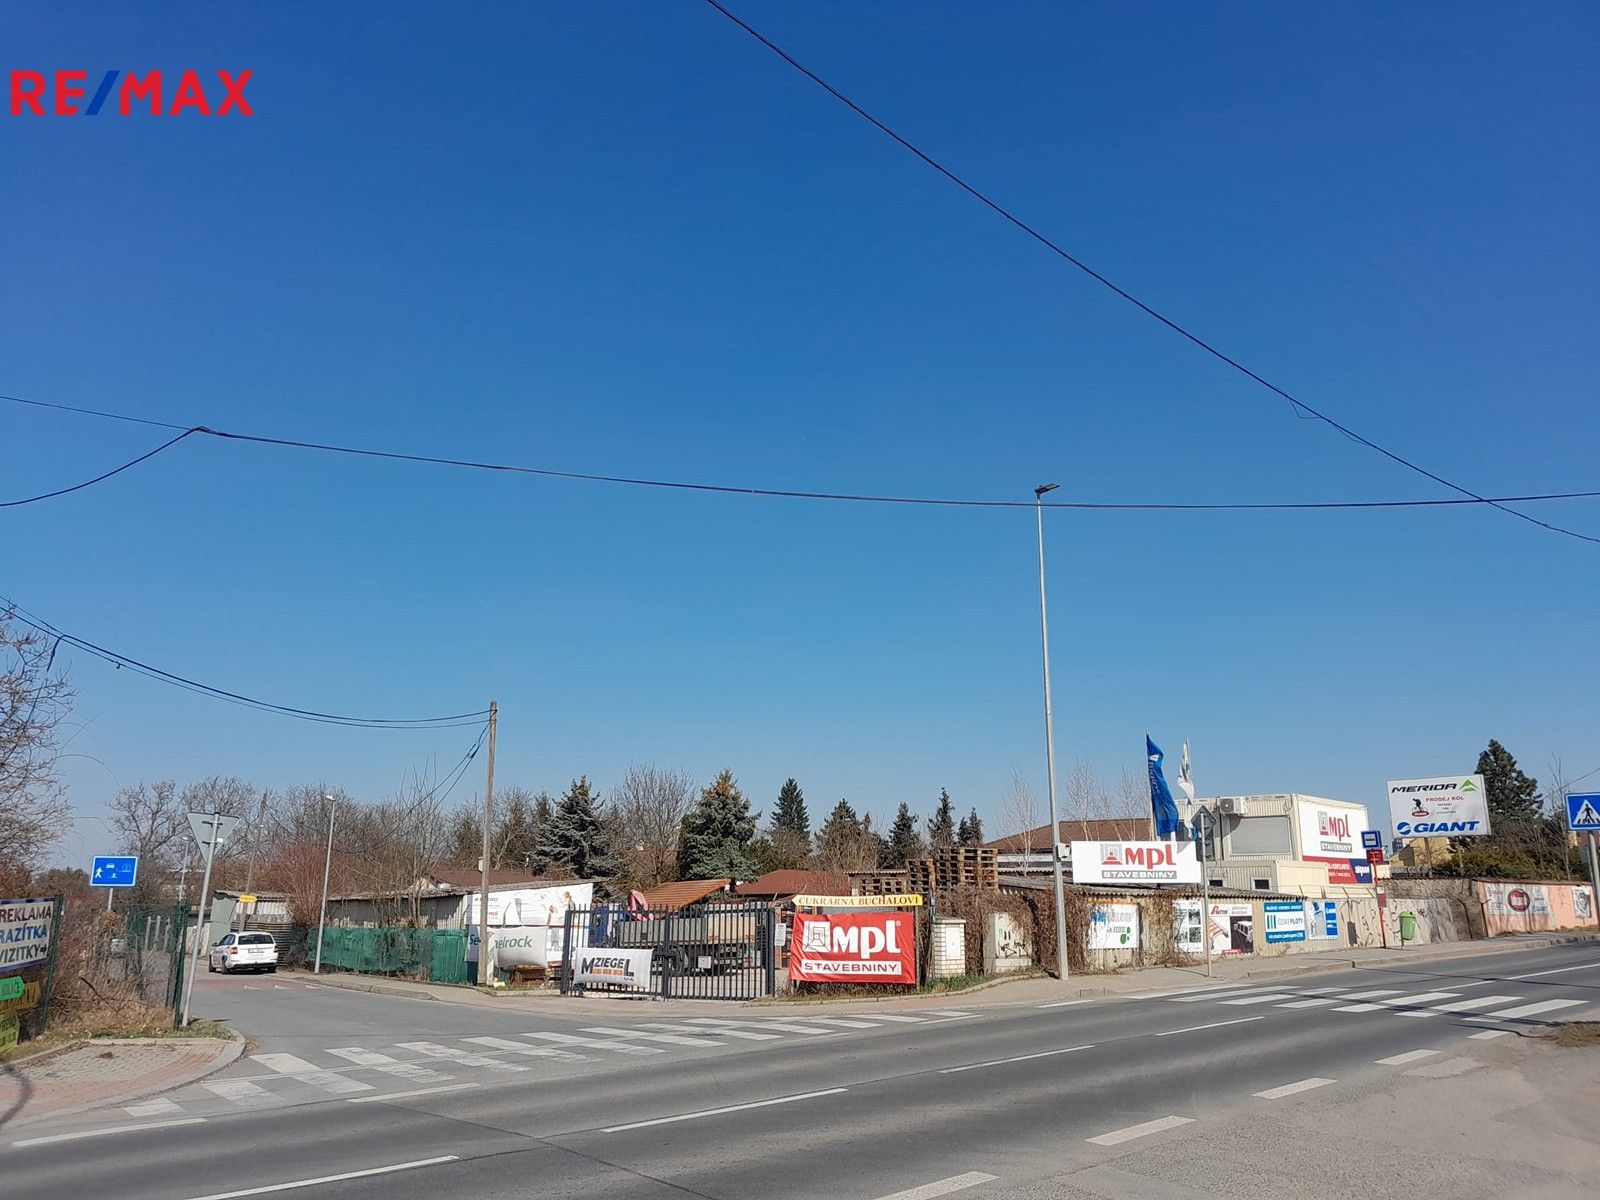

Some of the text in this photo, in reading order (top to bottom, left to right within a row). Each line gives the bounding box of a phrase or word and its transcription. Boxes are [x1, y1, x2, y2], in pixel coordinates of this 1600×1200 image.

[1391, 783, 1457, 793] MERIDA
[1413, 821, 1480, 833] GIANT
[0, 906, 51, 923] REKLAMA
[805, 963, 897, 972] STAVEBNINY
